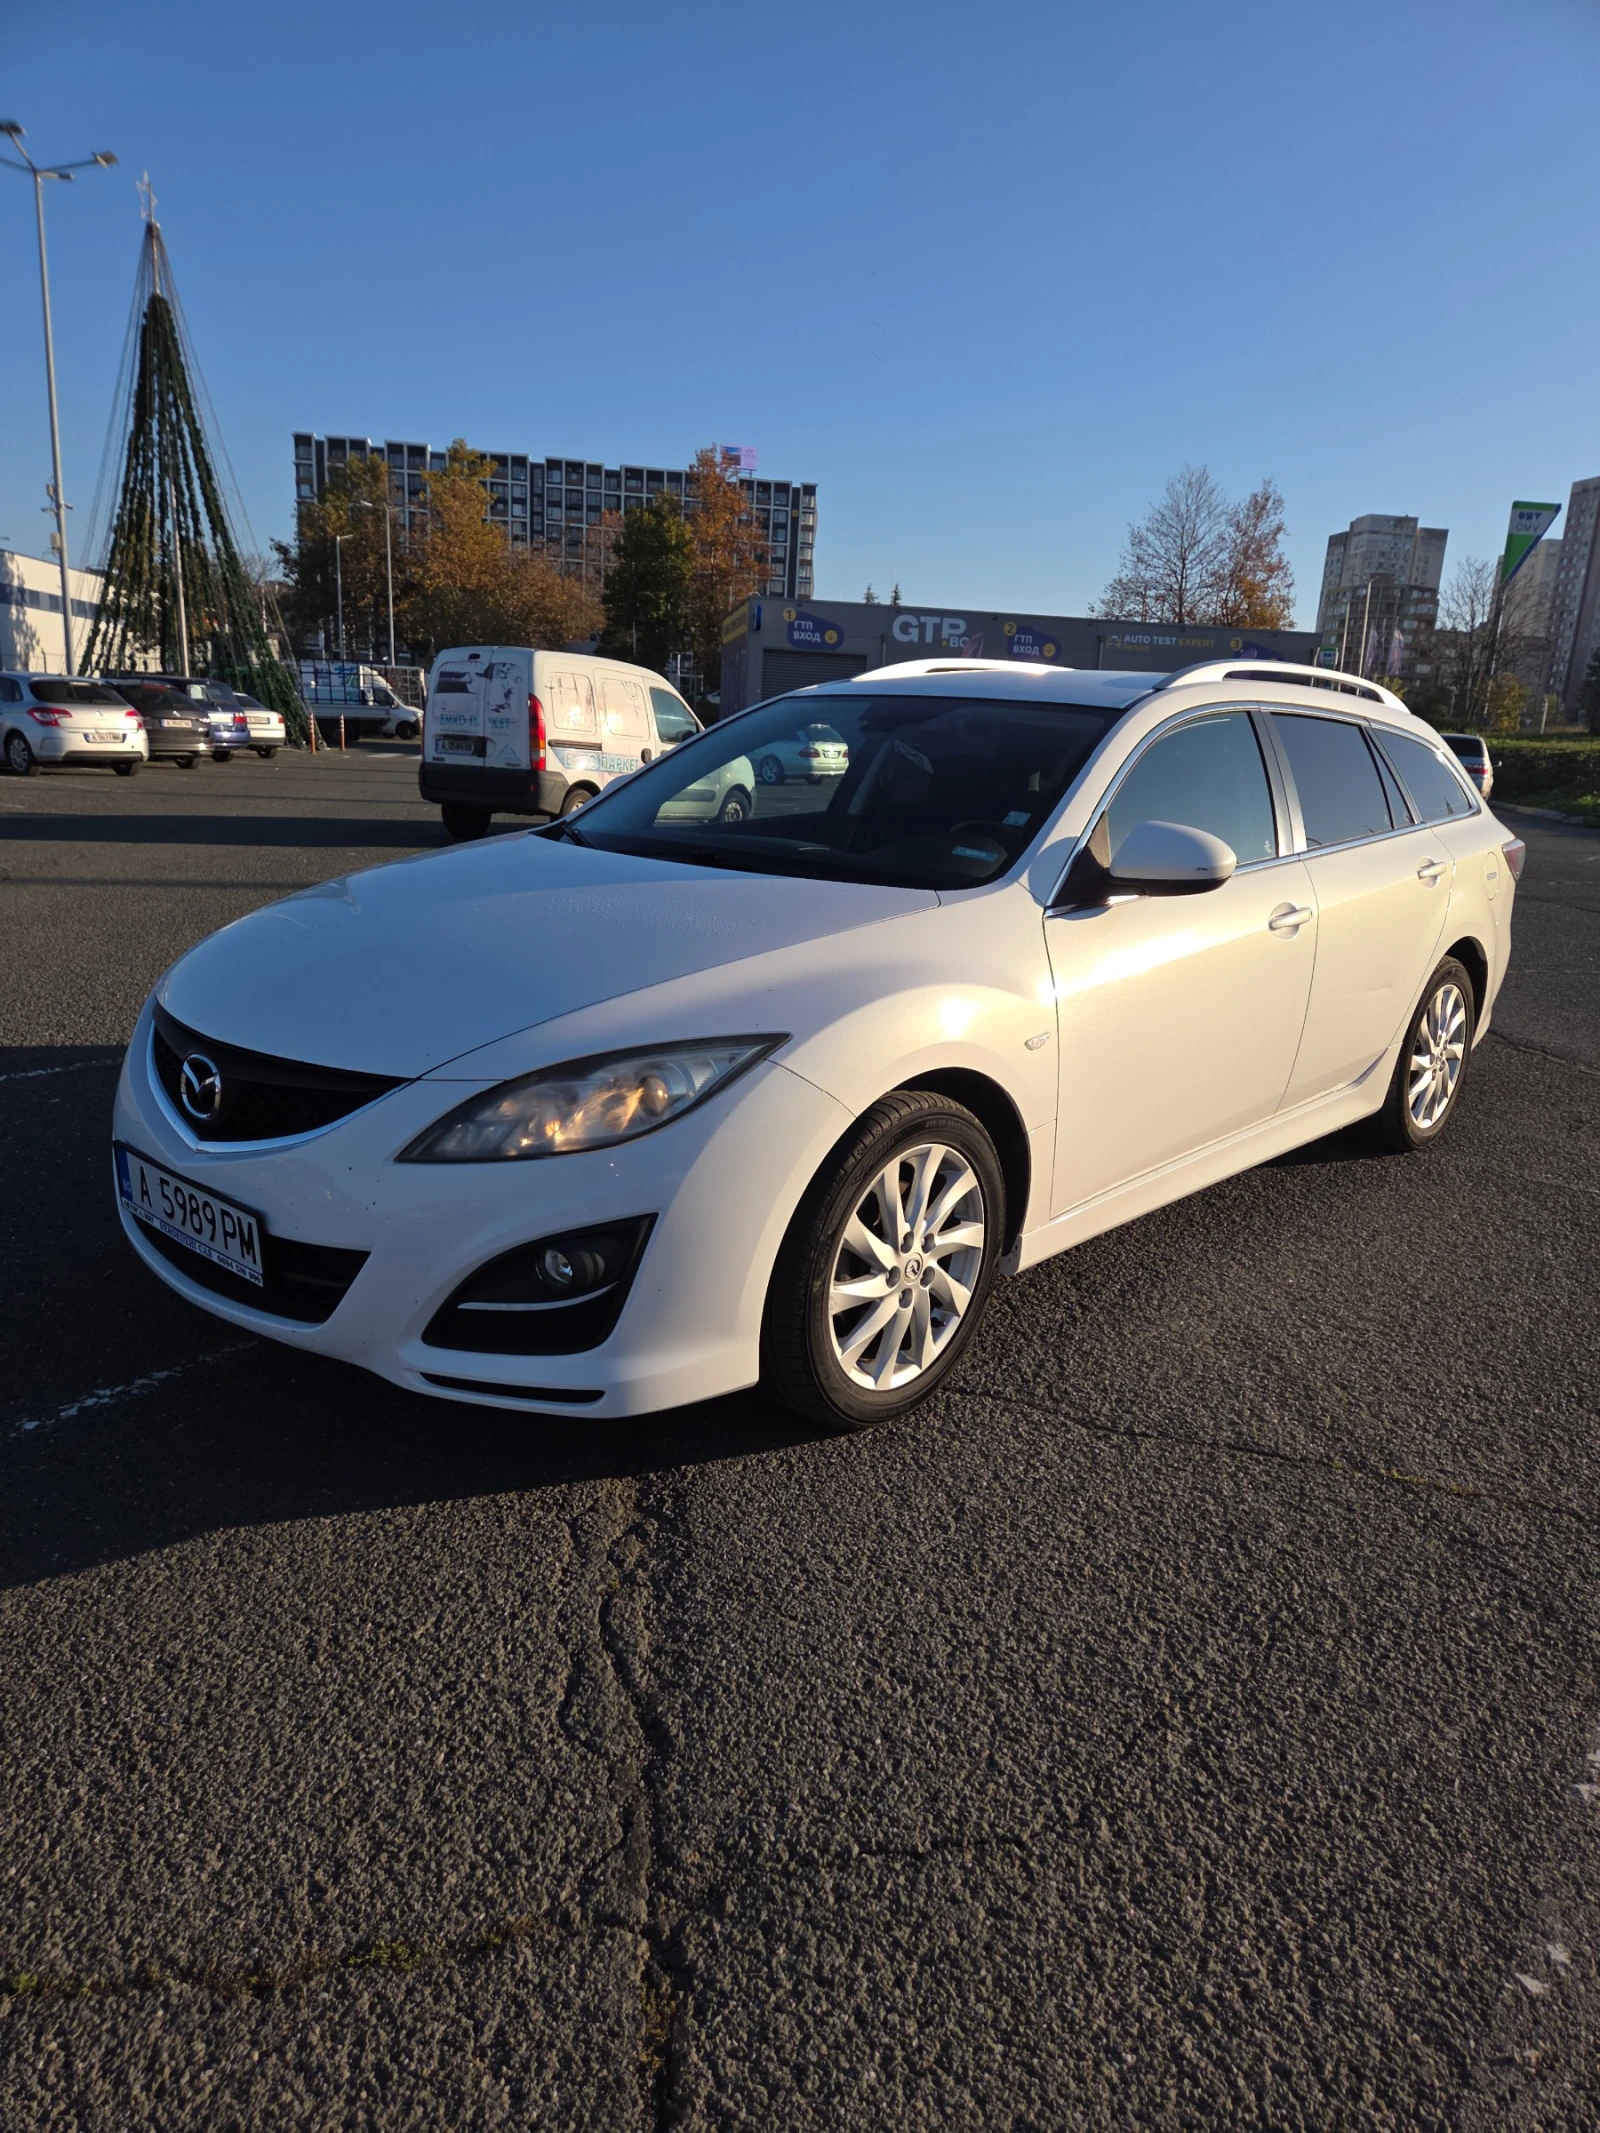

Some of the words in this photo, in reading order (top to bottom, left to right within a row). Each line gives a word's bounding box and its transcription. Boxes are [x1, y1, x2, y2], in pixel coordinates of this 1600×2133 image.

[1516, 522, 1540, 532] OMV
[794, 620, 813, 630] ГТП
[892, 614, 967, 644] GTP
[793, 631, 821, 643] ВХОД
[1014, 634, 1033, 644] ГТП
[1123, 634, 1151, 644] AUTO
[1152, 636, 1177, 646] TEST
[1178, 638, 1216, 648] EXPERT
[1013, 645, 1040, 656] ВХОД
[601, 754, 640, 772] ПАРКЕТ
[139, 1165, 153, 1208] A
[159, 1176, 217, 1242] 5989
[220, 1208, 257, 1266] PM
[198, 1244, 214, 1259] CAR
